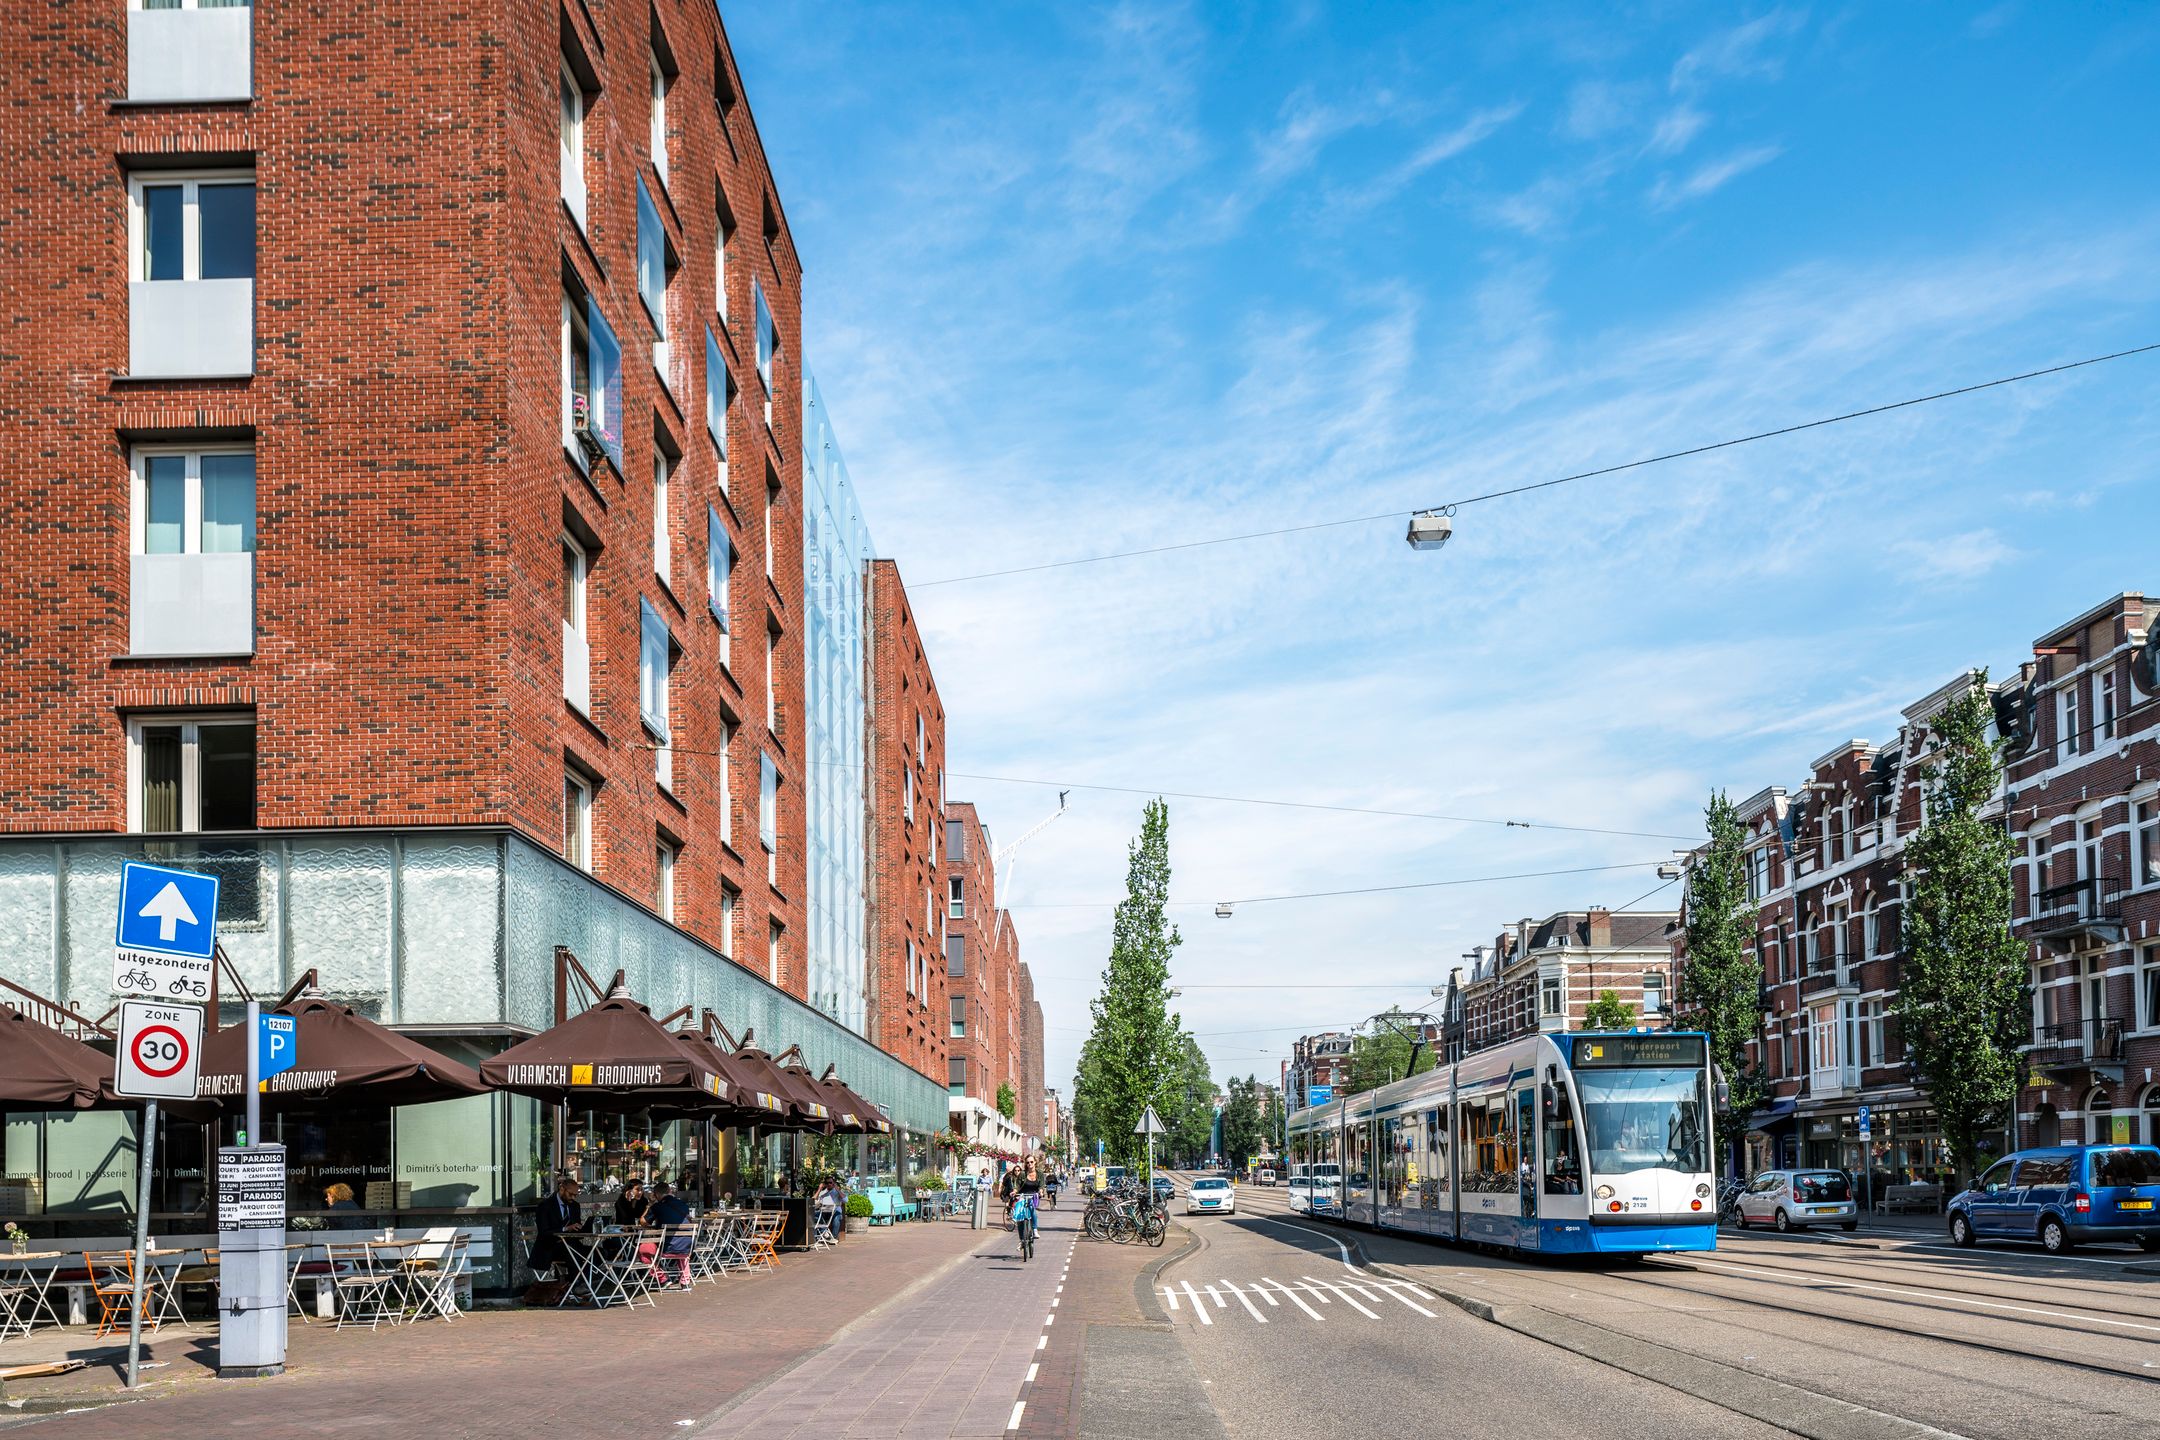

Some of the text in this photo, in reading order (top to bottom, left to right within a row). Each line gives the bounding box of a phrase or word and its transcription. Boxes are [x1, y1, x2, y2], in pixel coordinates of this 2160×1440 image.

[118, 952, 210, 971] uitgezonderd
[145, 1009, 181, 1022] ZONE
[269, 1020, 291, 1030] 12107
[142, 1040, 179, 1061] 30
[270, 1034, 285, 1060] P
[1584, 1042, 1681, 1061] 3 Muiderpoort
[1635, 1051, 1670, 1059] station
[507, 1064, 567, 1085] VLAAMSCH
[597, 1064, 662, 1085] BROODHUYS
[197, 1070, 338, 1096] AAMSCH BROODHUYS
[1860, 1108, 1867, 1122] P
[243, 1154, 282, 1163] PARADISO
[47, 1169, 73, 1179] brood
[85, 1169, 127, 1180] passerie
[286, 1166, 306, 1174] rood
[319, 1165, 361, 1177] patisserie
[369, 1164, 392, 1174] lunch
[405, 1164, 441, 1173] Dimitri's
